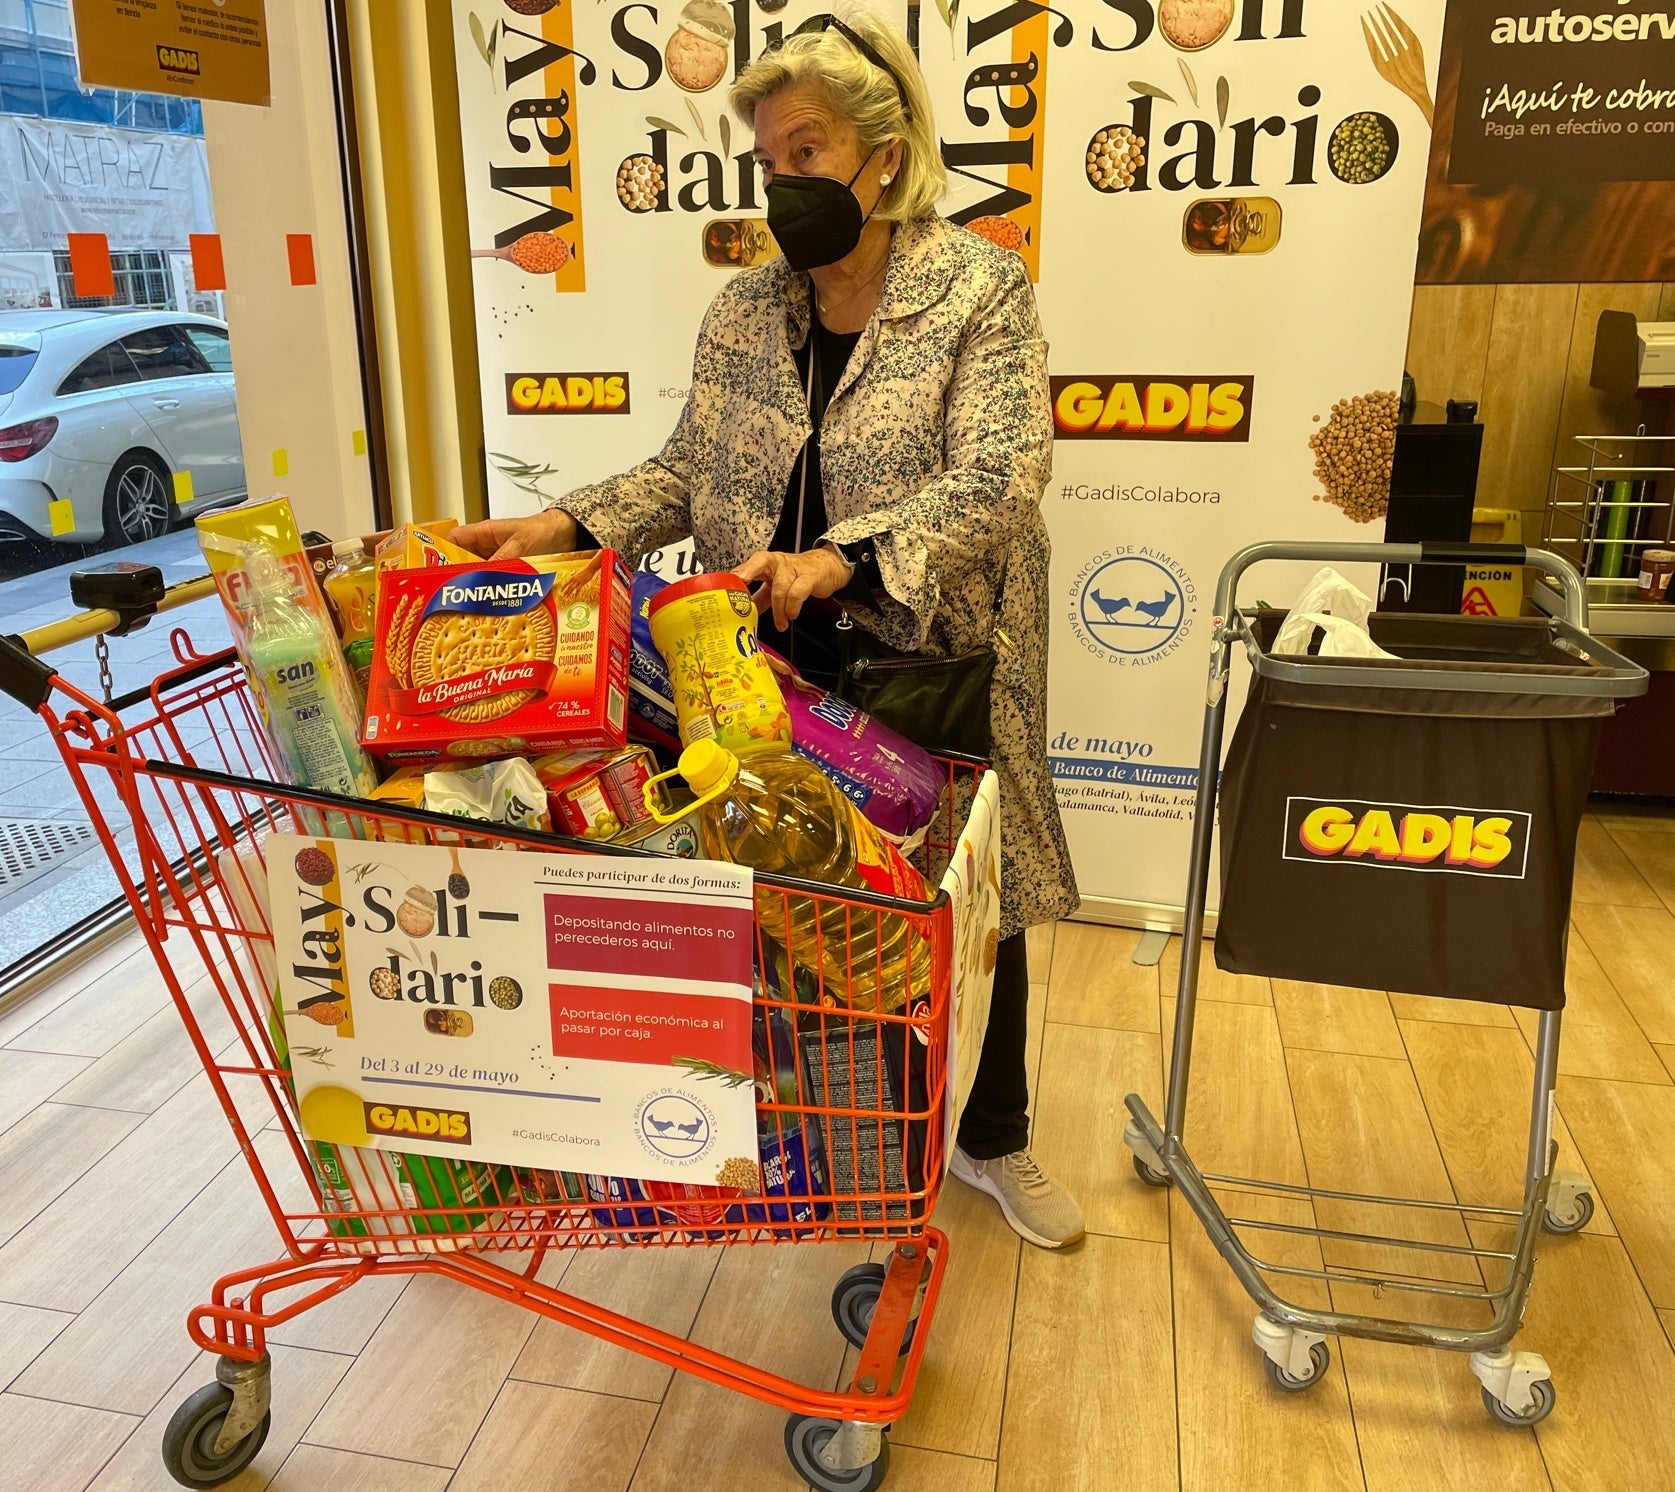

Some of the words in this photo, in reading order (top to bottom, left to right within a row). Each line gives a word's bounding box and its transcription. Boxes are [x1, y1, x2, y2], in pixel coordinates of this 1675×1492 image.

[159, 48, 198, 70] GADIS
[1481, 81, 1568, 119] ¡Aquí
[1571, 82, 1602, 112] te
[1085, 85, 1400, 193] dario
[1484, 121, 1525, 140] Paga
[1530, 123, 1550, 135] en
[1556, 118, 1622, 135] efectivo
[1627, 122, 1639, 134] o
[1643, 121, 1675, 134] con
[18, 128, 168, 190] MATRAZ
[616, 129, 769, 214] dar
[510, 376, 627, 412] GADIS
[1056, 382, 1246, 434] GADIS
[1061, 485, 1221, 504] #GadisColabora
[1069, 550, 1111, 598] BANCOS
[1115, 545, 1134, 555] DE
[1139, 545, 1198, 603] ALIMENTOS
[441, 578, 544, 606] FONTANEDA
[508, 599, 523, 608] 1881
[560, 631, 595, 644] CUIDANDO
[1068, 612, 1105, 659] BANCOS
[1108, 655, 1126, 666] DE
[1131, 618, 1193, 666] ALIMENTOS
[276, 661, 315, 684] san
[558, 653, 593, 667] CUIDAMOS
[417, 688, 432, 704] la
[433, 678, 483, 703] Buena
[484, 663, 534, 686] María
[453, 688, 491, 703] ORIGINAL
[556, 709, 591, 717] CEREALES
[557, 702, 568, 710] 74
[1050, 732, 1079, 750] de
[1084, 736, 1154, 760] mayo
[1054, 761, 1104, 777] Banco
[1107, 765, 1126, 780] de
[1129, 767, 1200, 787] Alimento
[1054, 784, 1078, 798] iago
[1082, 785, 1132, 802] (Balrial),
[1136, 791, 1169, 805] Ávila,
[1057, 798, 1118, 815] alamanca,
[1122, 804, 1183, 821] Valladolid,
[1299, 806, 1513, 868] GADIS
[543, 866, 584, 879] Puedes
[587, 870, 649, 883] participar
[651, 873, 666, 884] de
[669, 876, 689, 888] dos
[690, 875, 741, 889] formas:
[554, 914, 641, 932] Depositando
[645, 921, 713, 938] alimentos
[717, 927, 735, 939] no
[555, 931, 638, 948] perecederos
[642, 938, 675, 951] aquí.
[369, 956, 523, 1011] dario
[560, 1007, 632, 1023] Aportación
[635, 1013, 708, 1029] económica
[712, 1019, 724, 1030] al
[561, 1023, 595, 1034] pasar
[600, 1027, 620, 1038] por
[625, 1027, 653, 1040] caja.
[361, 1056, 386, 1071] Del
[390, 1060, 399, 1072] 3
[404, 1060, 420, 1074] al
[425, 1063, 444, 1076] 29
[449, 1063, 468, 1079] de
[472, 1069, 519, 1086] mayo
[633, 1090, 659, 1119] BANCOS
[676, 1088, 718, 1128] ALIMENTOS
[369, 1106, 469, 1139] GADIS
[512, 1129, 601, 1147] #GadisColabora
[634, 1128, 660, 1161] BANCOS
[663, 1158, 675, 1167] DE
[678, 1136, 717, 1167] ALIMENTOS
